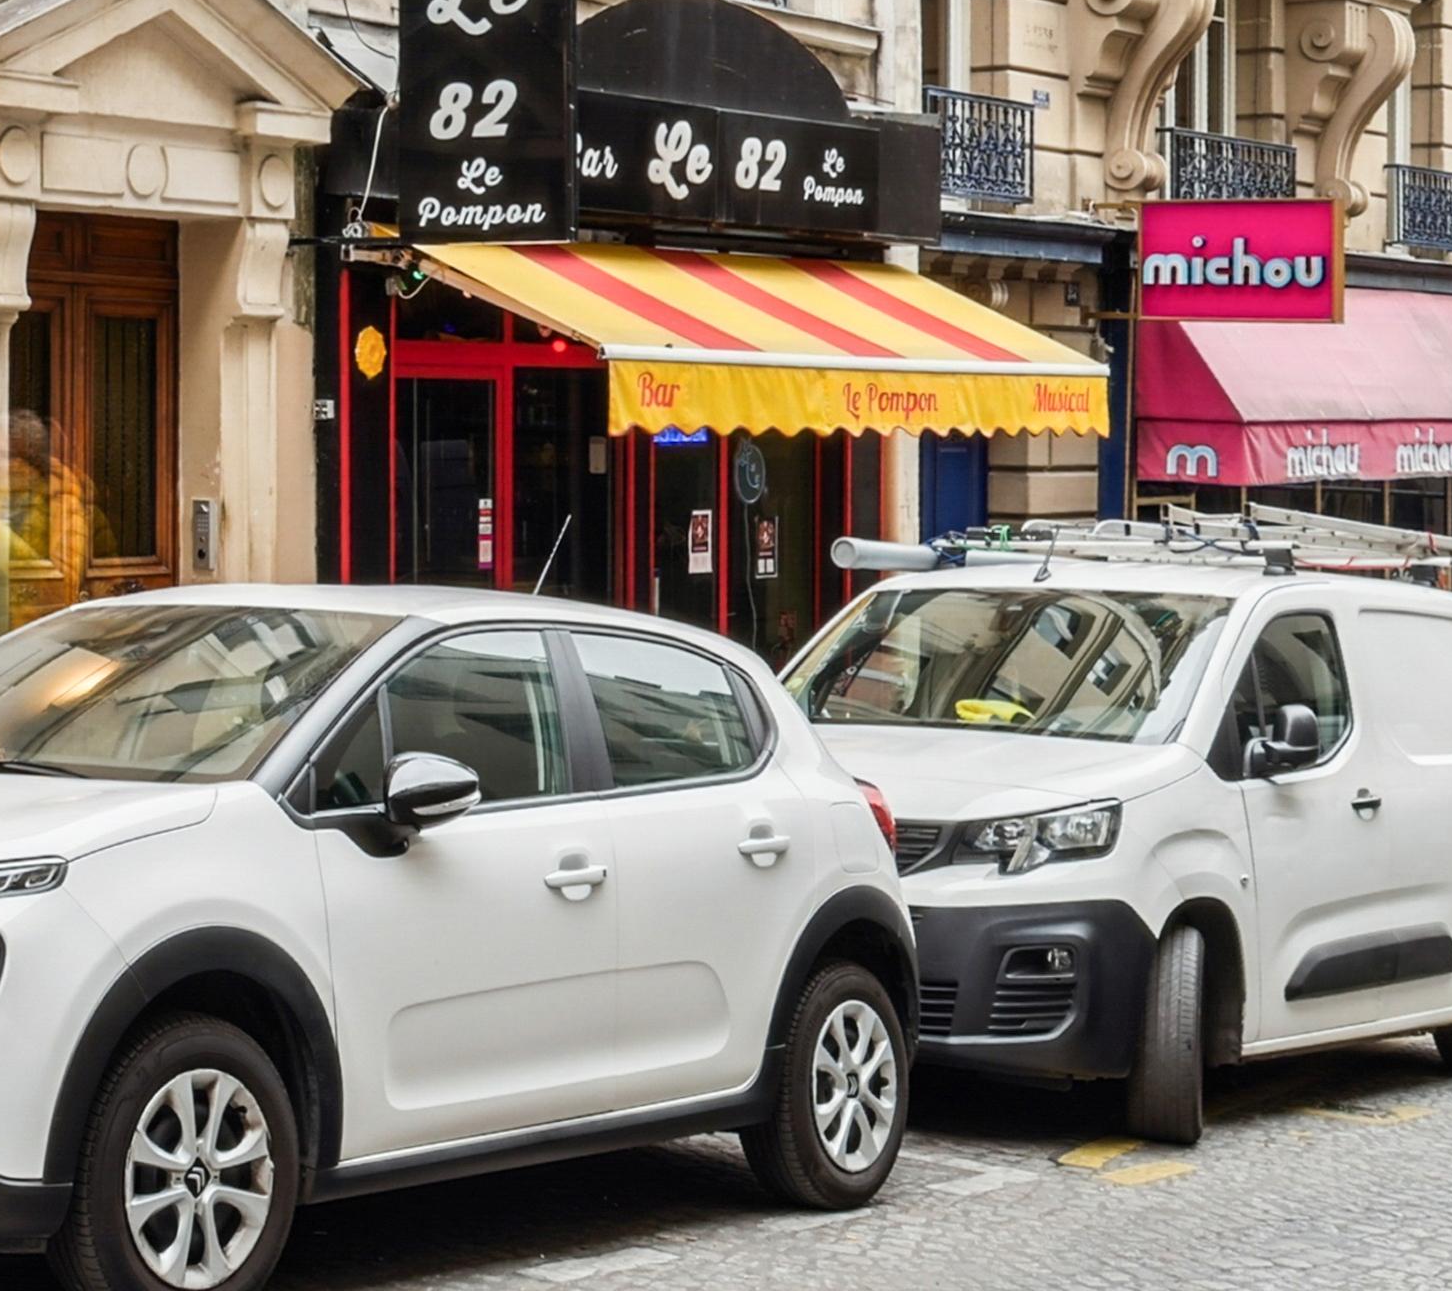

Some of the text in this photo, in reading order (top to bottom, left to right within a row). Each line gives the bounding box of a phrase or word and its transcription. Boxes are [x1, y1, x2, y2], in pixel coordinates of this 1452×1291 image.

[429, 79, 518, 141] 82
[457, 157, 503, 194] Le
[647, 120, 713, 201] Le
[735, 136, 787, 192] 82
[822, 148, 846, 179] Le
[418, 197, 546, 231] Pompon
[802, 175, 865, 208] Pompon
[1142, 234, 1326, 290] michou
[637, 371, 1091, 419] Bar Le Pompon Musical
[1166, 444, 1218, 478] m
[1286, 428, 1361, 479] michou
